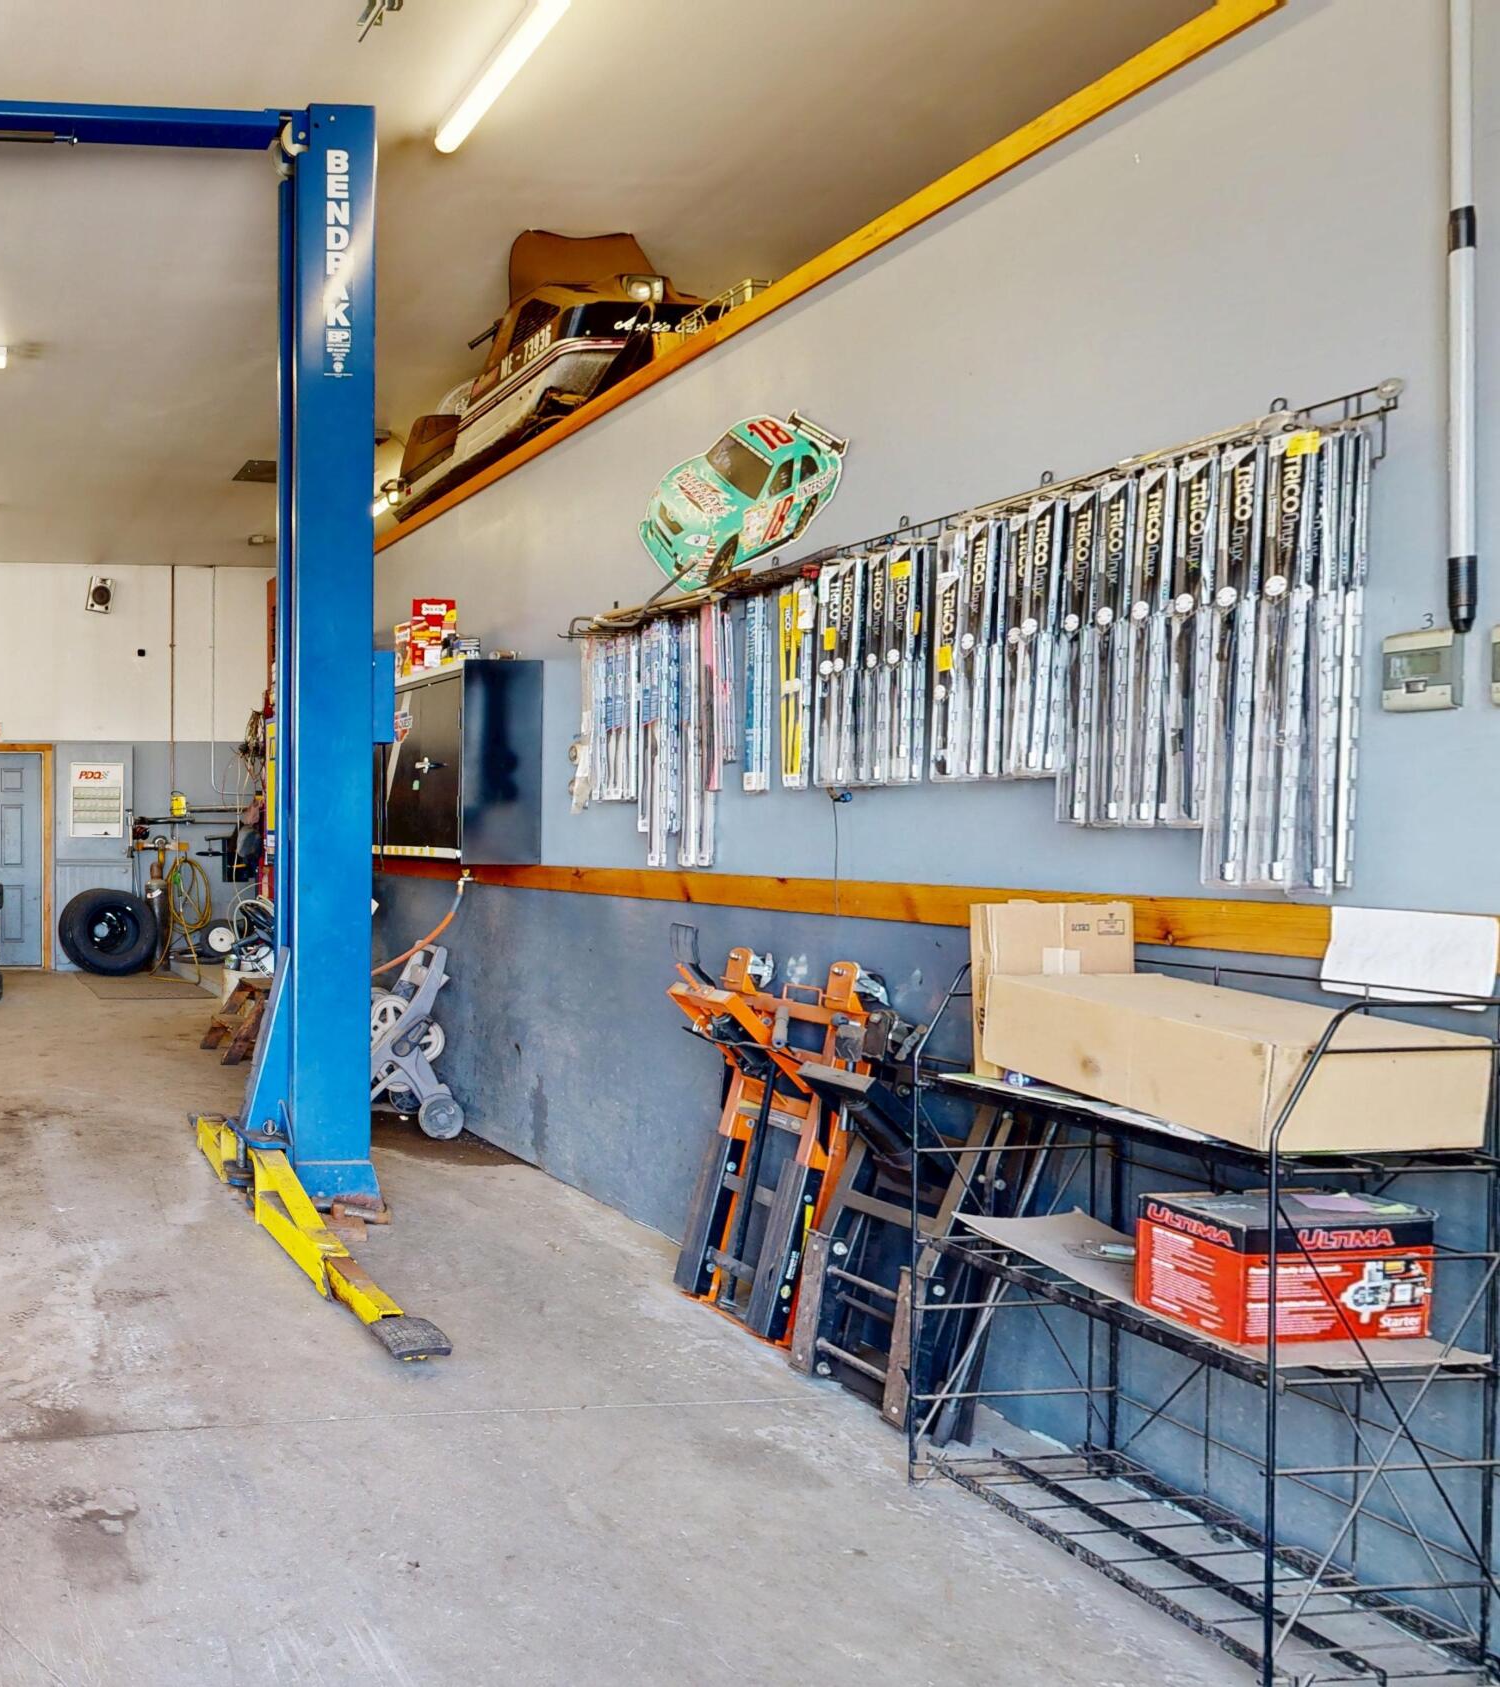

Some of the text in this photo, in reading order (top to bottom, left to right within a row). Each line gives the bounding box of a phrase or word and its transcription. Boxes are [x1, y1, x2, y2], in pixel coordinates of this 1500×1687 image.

[746, 418, 795, 452] 18
[1189, 477, 1207, 536] TRICO
[1282, 455, 1302, 513] TRICO
[1108, 499, 1125, 553] TRICO
[1146, 488, 1163, 544] TRICO
[1229, 461, 1256, 562] TRICO Onyx
[1034, 514, 1051, 567] TRICO
[1076, 509, 1092, 562] TRICO
[972, 537, 987, 585] TRICO
[842, 574, 854, 616] TRICO
[873, 568, 884, 610] TRICO
[895, 575, 908, 605] RICO
[941, 588, 956, 635] TRICO
[1421, 612, 1434, 630] 3
[1146, 1202, 1235, 1248] ULTIMA
[1297, 1228, 1395, 1250] ULTIMA
[1379, 1315, 1421, 1328] Starter
